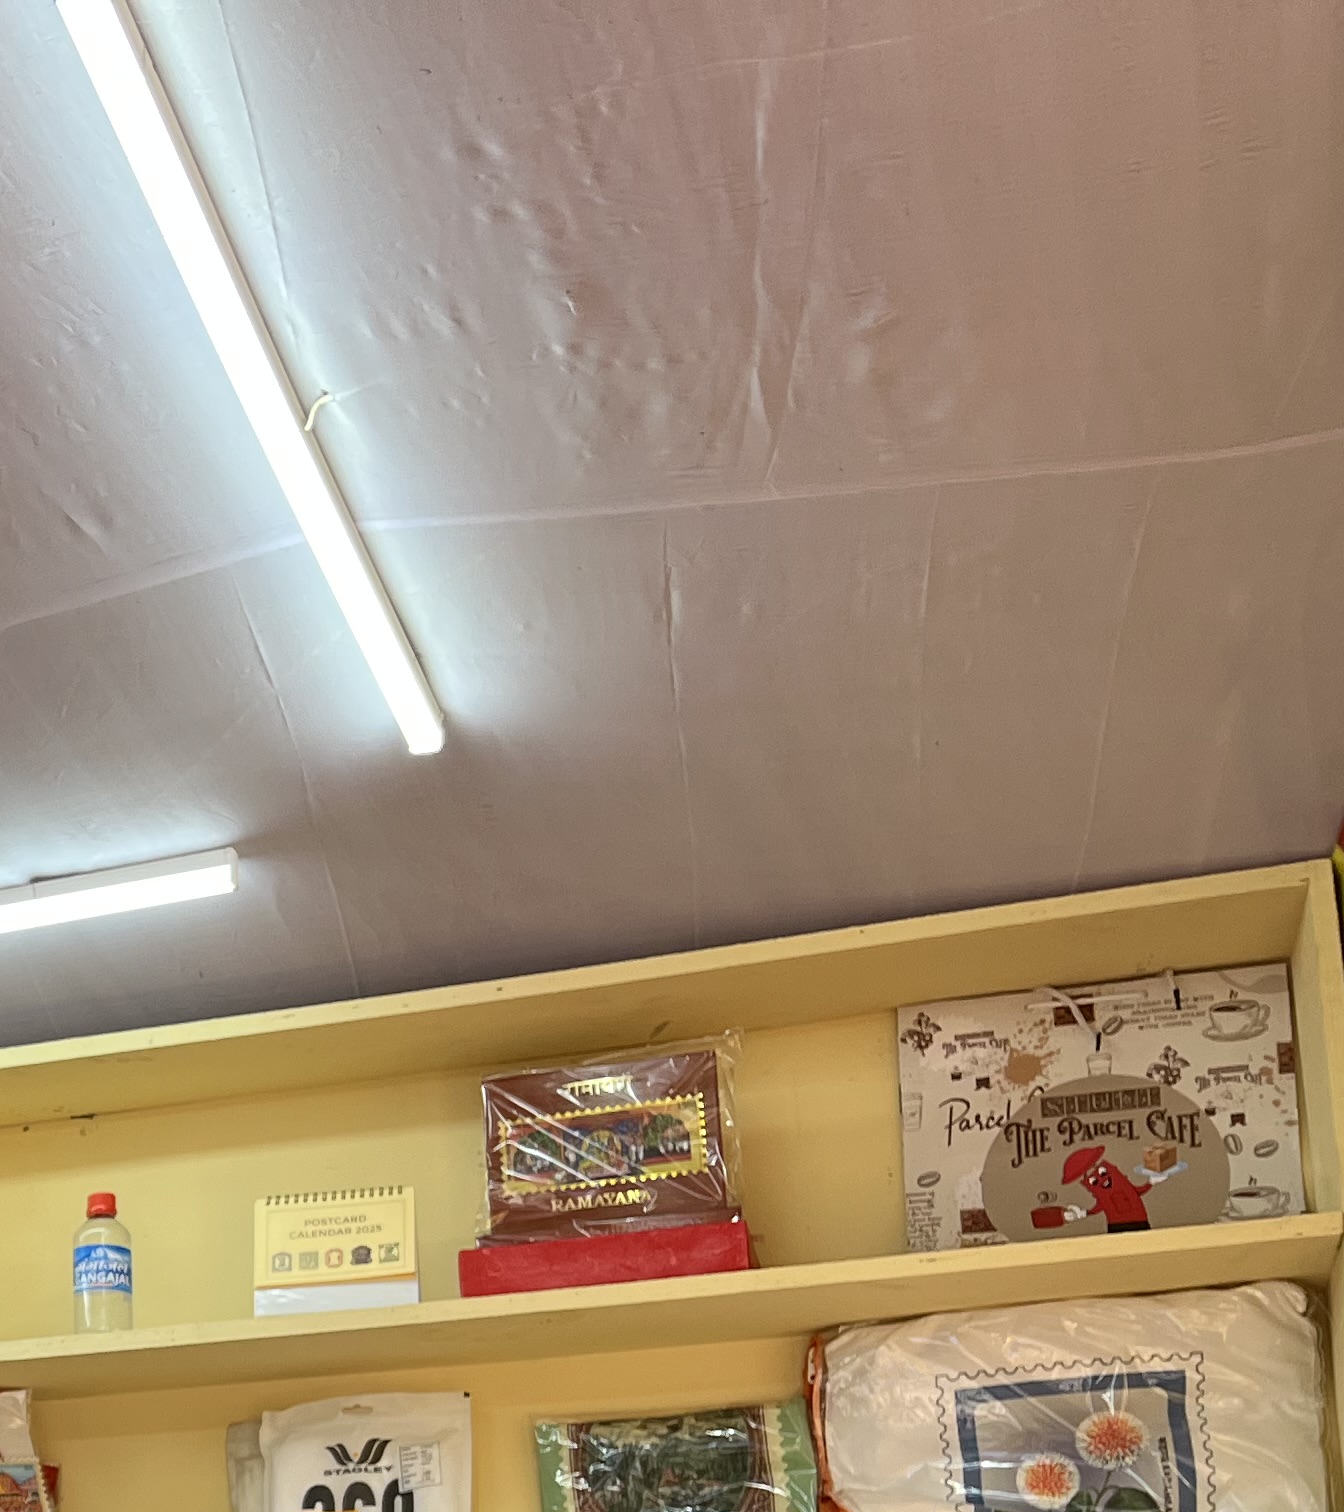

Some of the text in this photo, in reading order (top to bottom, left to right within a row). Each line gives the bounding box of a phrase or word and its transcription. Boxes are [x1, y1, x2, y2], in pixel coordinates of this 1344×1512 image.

[550, 1188, 652, 1213] RAMAYANA
[303, 1214, 368, 1228] POSTCARD
[288, 1226, 352, 1241] CALENDAR
